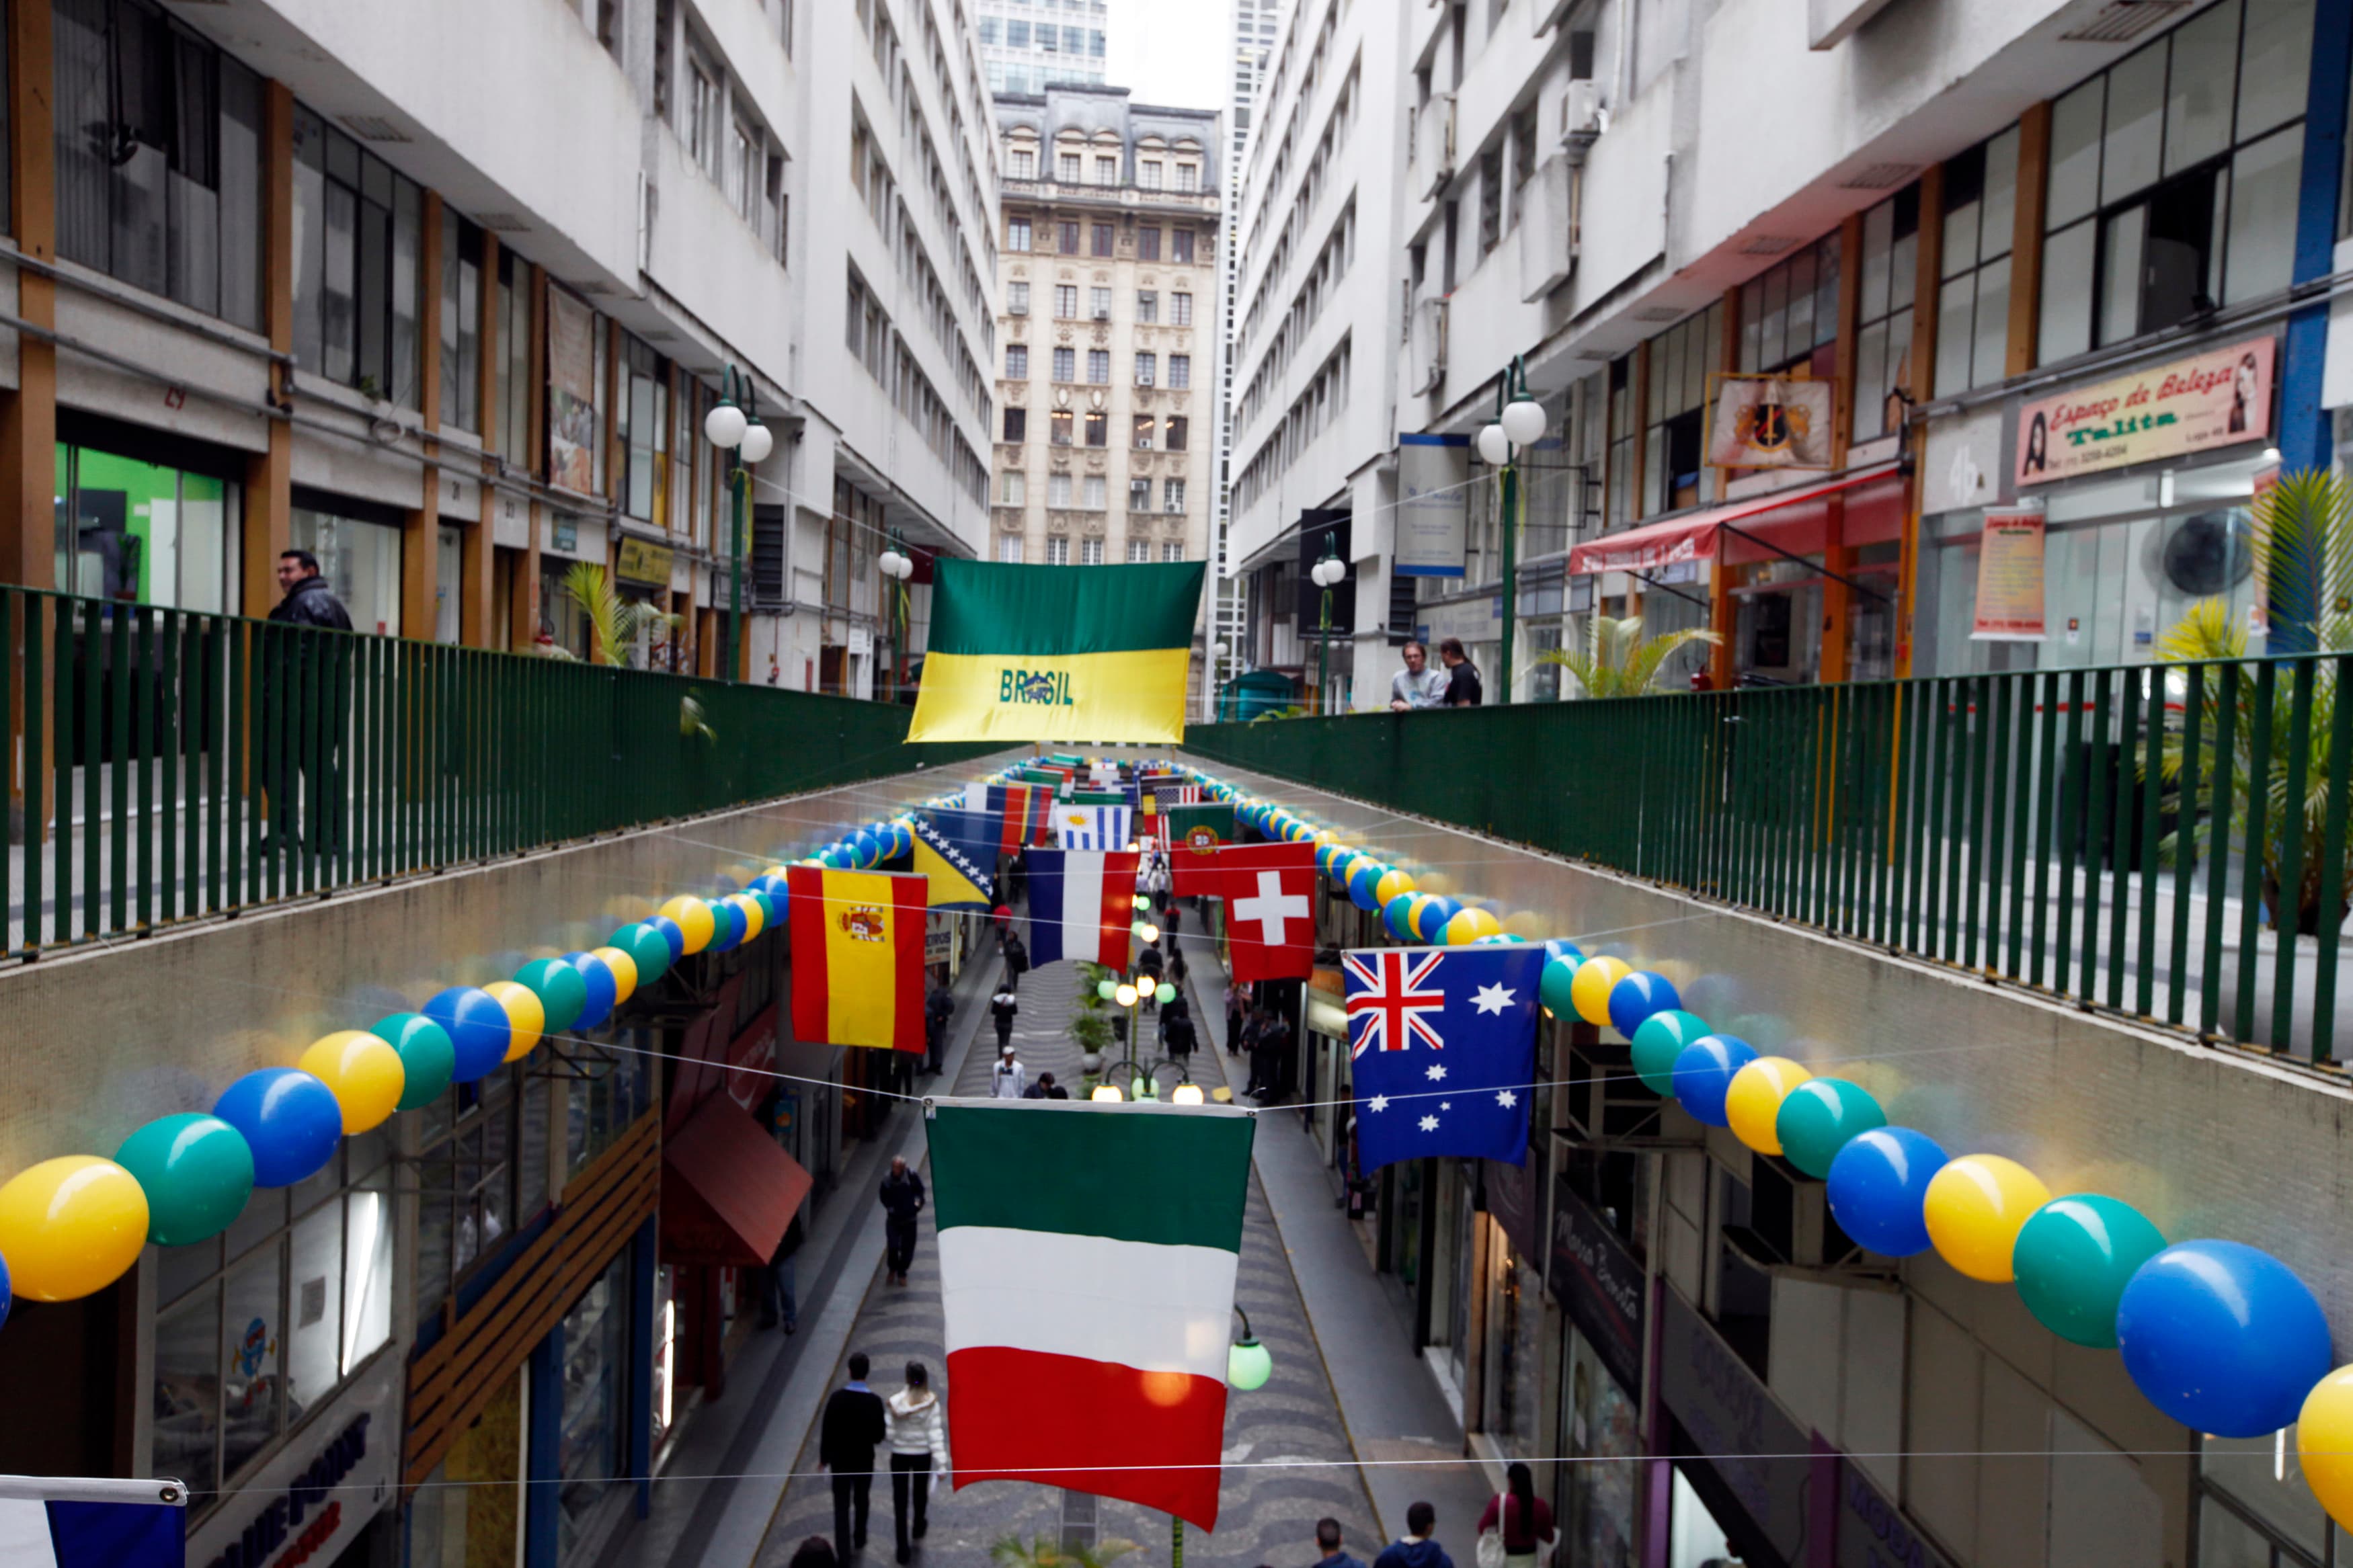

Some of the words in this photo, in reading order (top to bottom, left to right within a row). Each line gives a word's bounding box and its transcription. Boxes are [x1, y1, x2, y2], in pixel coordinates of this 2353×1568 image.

[2124, 382, 2149, 409] de
[2157, 367, 2233, 402] Beleza
[2067, 411, 2179, 446] Talita
